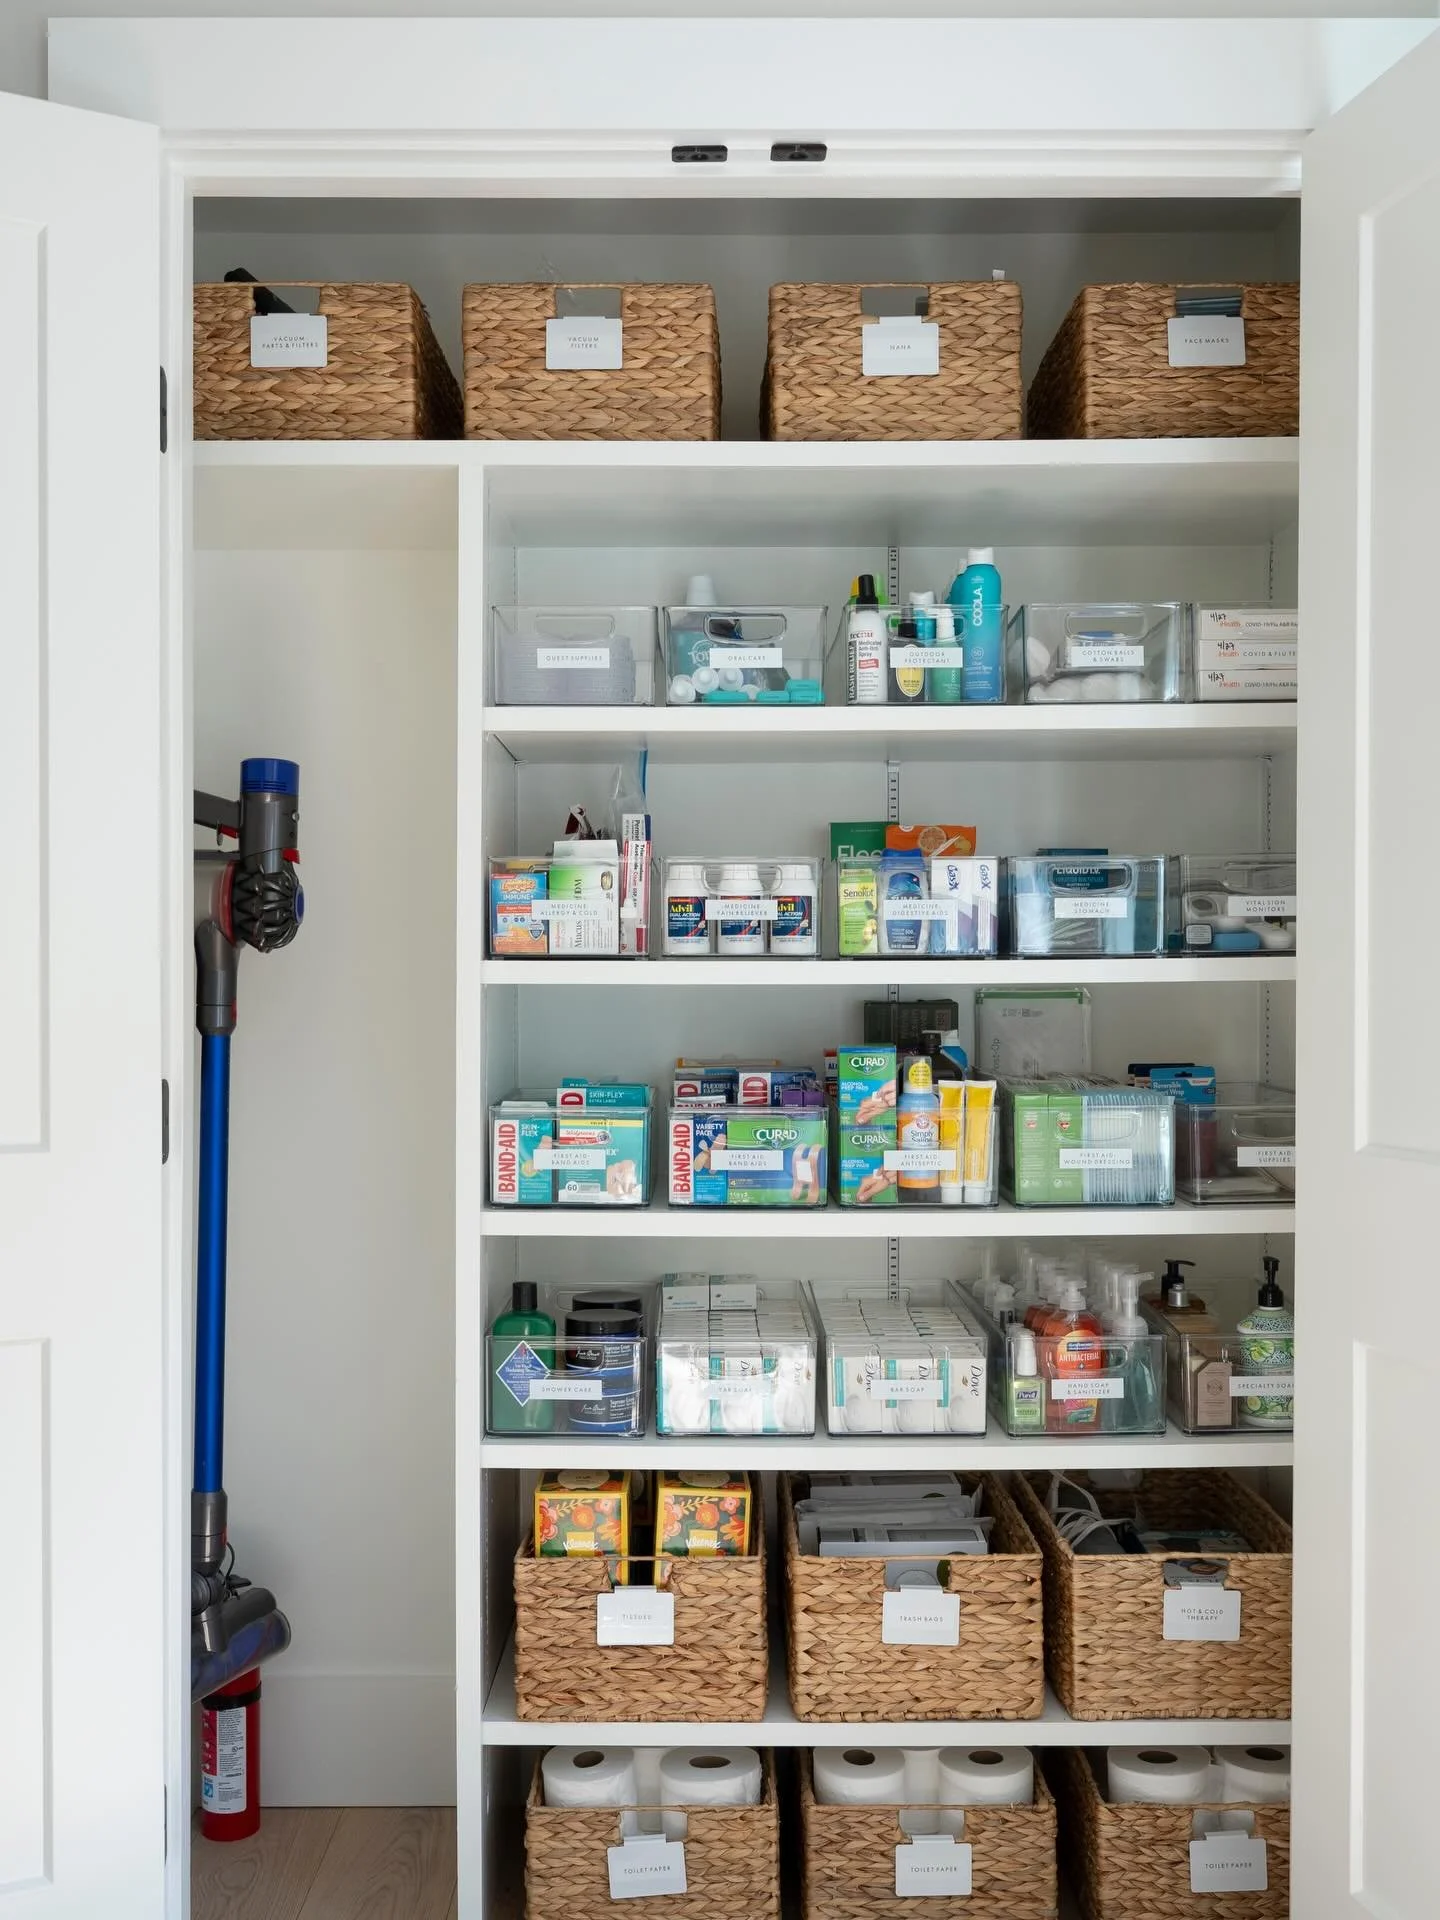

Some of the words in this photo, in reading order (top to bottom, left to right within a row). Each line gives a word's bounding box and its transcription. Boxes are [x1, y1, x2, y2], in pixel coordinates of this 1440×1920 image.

[973, 586, 983, 626] COOLA
[843, 889, 874, 898] Senokot
[669, 904, 693, 913] Advil
[776, 904, 794, 913] dvil
[850, 1057, 885, 1068] CURAD
[756, 1128, 798, 1141] CURAD
[851, 1134, 885, 1145] CURAD
[910, 1130, 935, 1138] Simply
[1059, 1352, 1101, 1362] ANTIBACTERIAL
[969, 1364, 983, 1397] Dove
[685, 1536, 721, 1550] Kleenex
